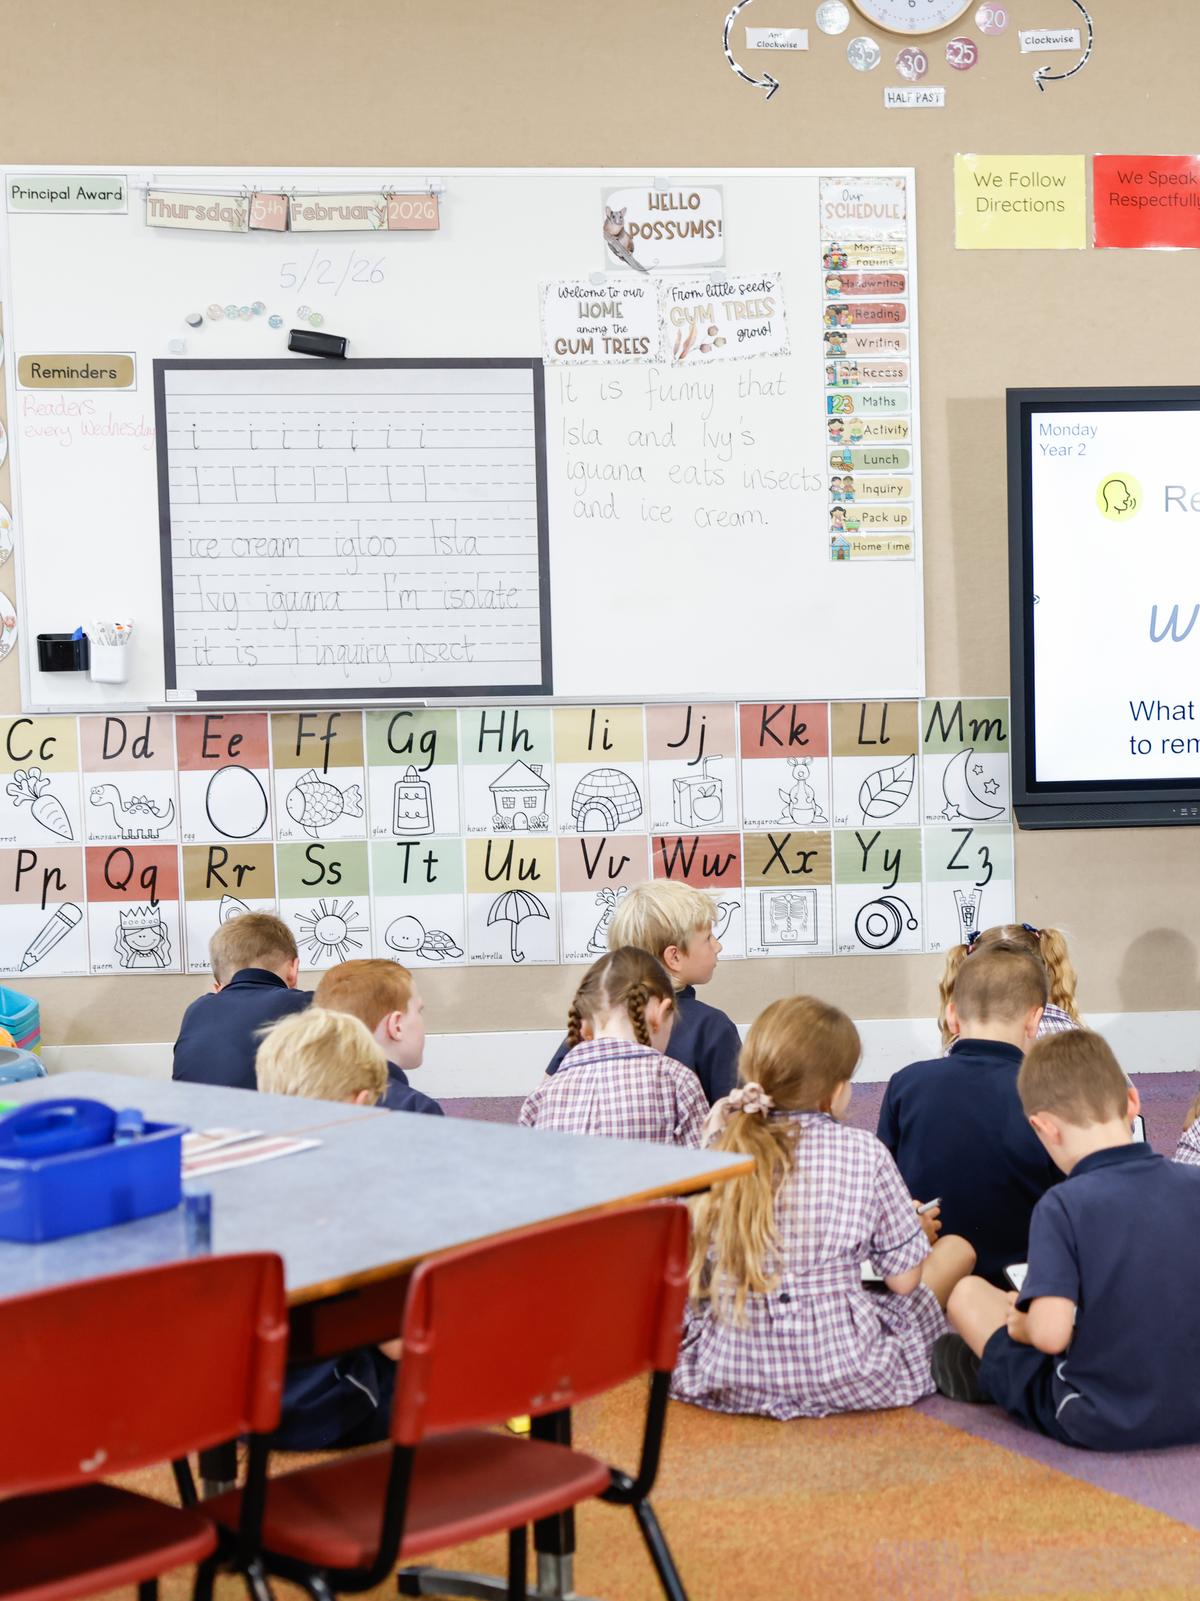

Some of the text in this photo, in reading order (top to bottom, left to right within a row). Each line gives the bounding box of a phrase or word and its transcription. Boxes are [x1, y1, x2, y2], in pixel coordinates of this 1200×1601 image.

[985, 9, 1006, 28] 20
[757, 40, 798, 49] Clockwise
[1024, 35, 1074, 45] Clockwise
[954, 43, 975, 65] 25
[904, 54, 926, 73] 30
[887, 92, 941, 104] HALF PAST
[973, 171, 1066, 188] We Follow
[1117, 170, 1198, 190] We Speak
[11, 185, 123, 203] Principal Award
[647, 192, 701, 211] HELLO
[841, 188, 864, 202] Our
[148, 198, 435, 226] Thursday 5th February 2026
[825, 202, 901, 220] SCHEDULE
[976, 196, 1066, 213] Directions
[628, 219, 723, 241] POSSUMS!
[279, 248, 387, 297] 5/2/26
[557, 286, 645, 299] Welcome to our
[671, 279, 775, 302] From little seeds
[578, 301, 624, 319] HOME
[669, 296, 778, 327] GUM TREES
[855, 308, 901, 322] Reading
[576, 323, 629, 337] among the
[736, 320, 772, 343] grow!
[554, 336, 651, 355] GUM TREES
[855, 336, 901, 352] Writing
[31, 362, 118, 380] Reminders
[862, 366, 904, 378] Recess
[560, 367, 787, 421] It is funny that
[862, 395, 897, 408] Maths
[23, 394, 97, 417] Readers
[25, 411, 157, 450] every Wednesday
[562, 415, 756, 463] Isla and Ivy's
[864, 423, 910, 438] Activity
[1039, 423, 1098, 440] Monday
[1039, 443, 1087, 457] Year 2
[863, 453, 900, 466] Lunch
[566, 452, 823, 496] iguana eats insects
[862, 483, 904, 497] Inquiry
[573, 491, 769, 529] and ice cream.
[862, 512, 908, 526] Pack up
[188, 530, 219, 559] ice
[231, 536, 304, 558] cream
[335, 519, 398, 575] igloo
[853, 542, 882, 552] Home
[197, 574, 239, 631] Ivy
[265, 583, 344, 630] iguana
[443, 572, 520, 611] isolate
[193, 634, 475, 683] it is inquiry insect
[1129, 698, 1195, 722] What
[1129, 735, 1152, 755] to
[467, 824, 487, 833] house
[743, 817, 779, 828] kangaroo
[279, 828, 293, 839] fish
[470, 953, 503, 961] umbrella
[92, 963, 113, 973] queen
